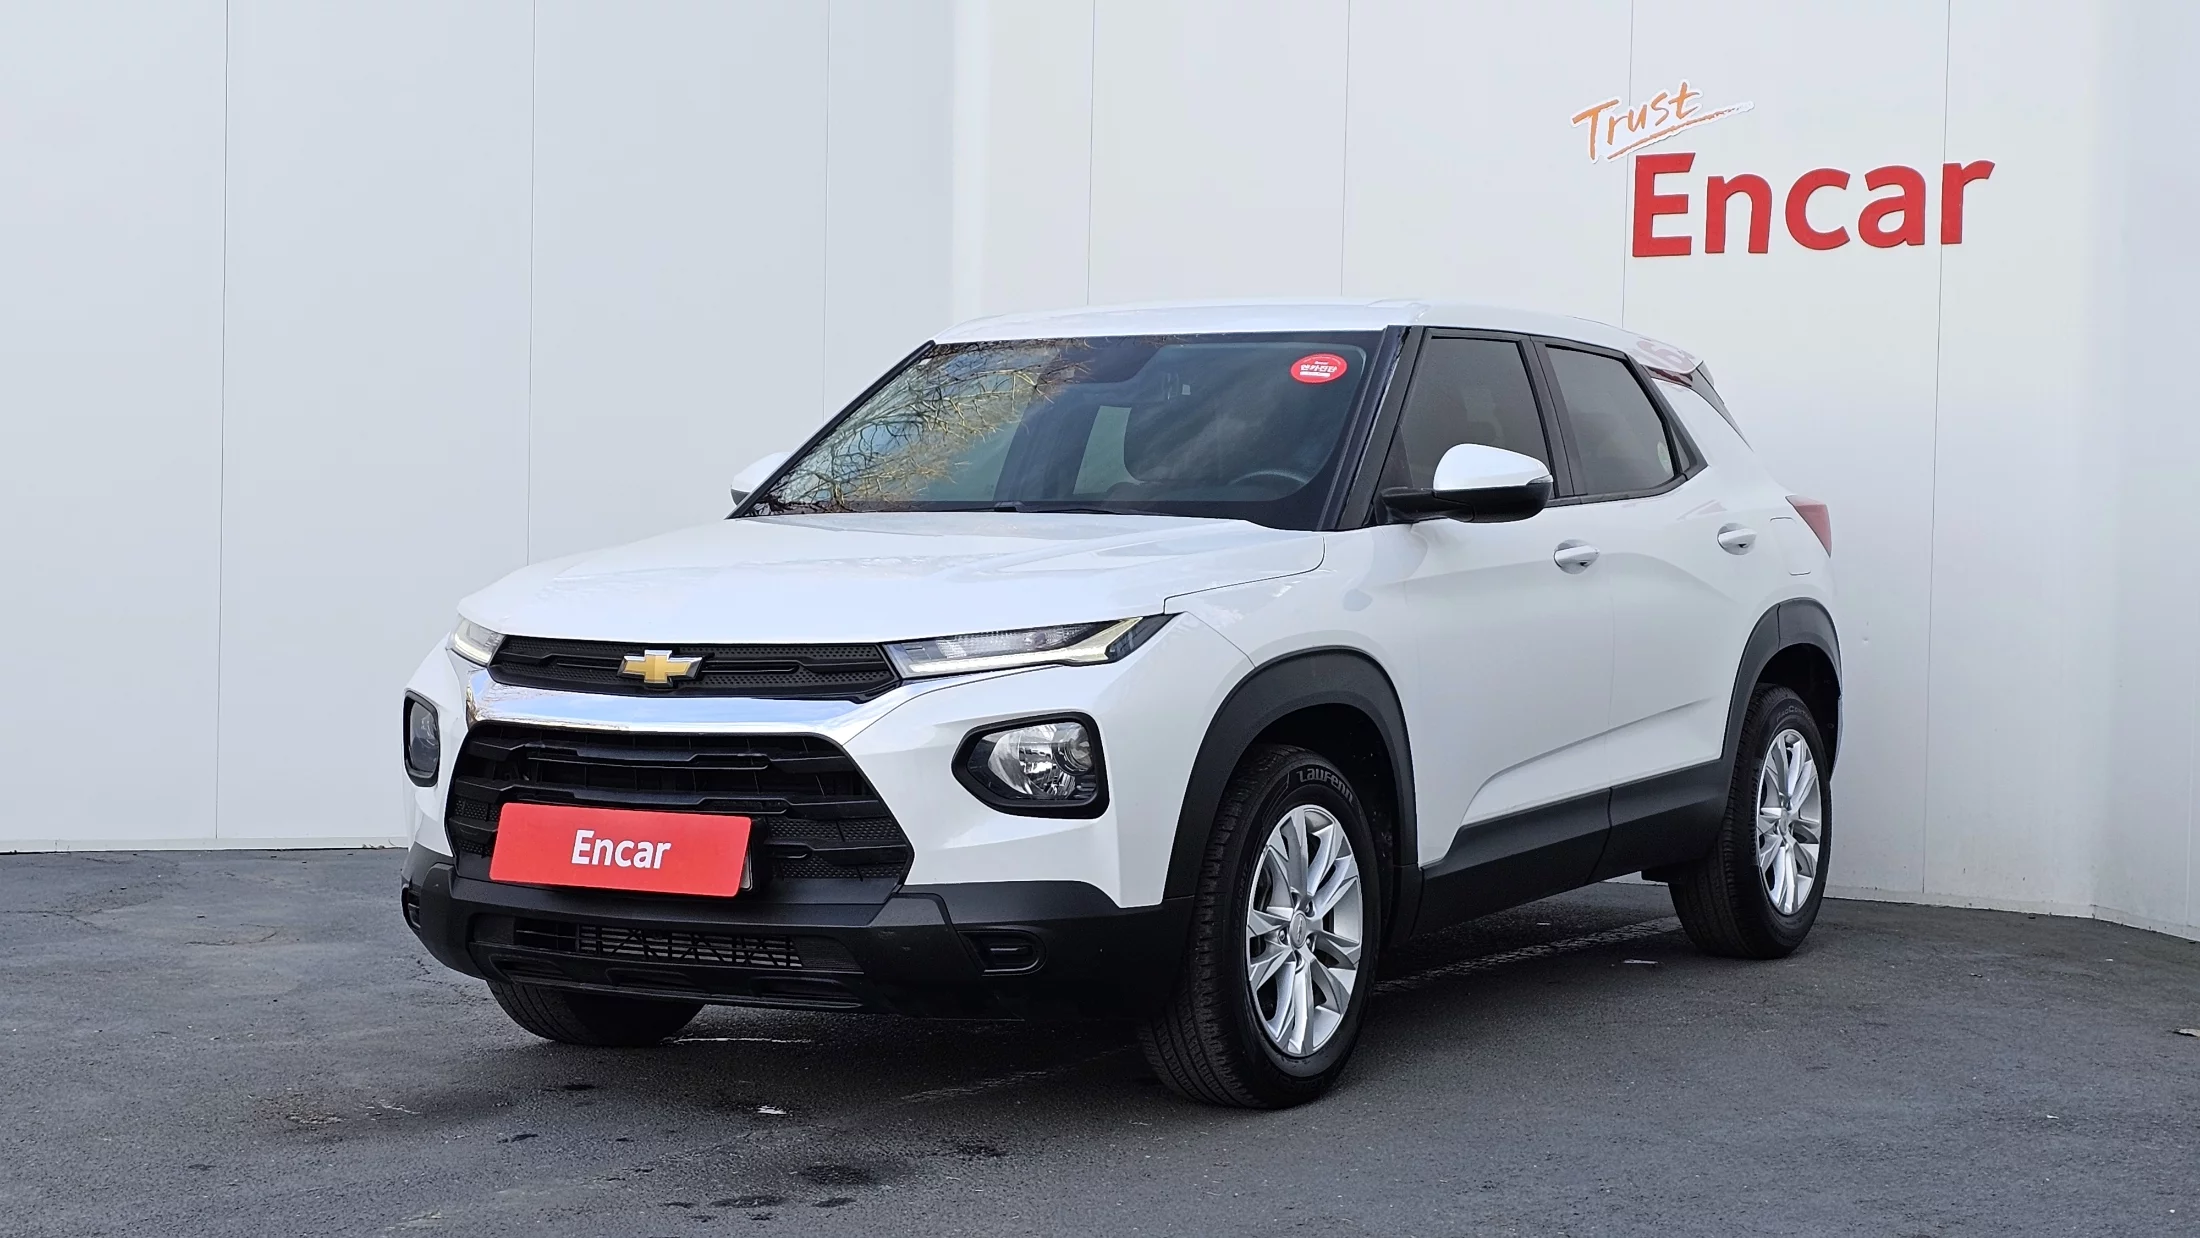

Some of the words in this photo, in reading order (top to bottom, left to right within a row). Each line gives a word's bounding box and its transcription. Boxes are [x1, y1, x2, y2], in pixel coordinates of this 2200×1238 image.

[1572, 82, 1702, 160] Trust
[1632, 152, 1996, 258] Encar
[570, 829, 672, 870] Encar
